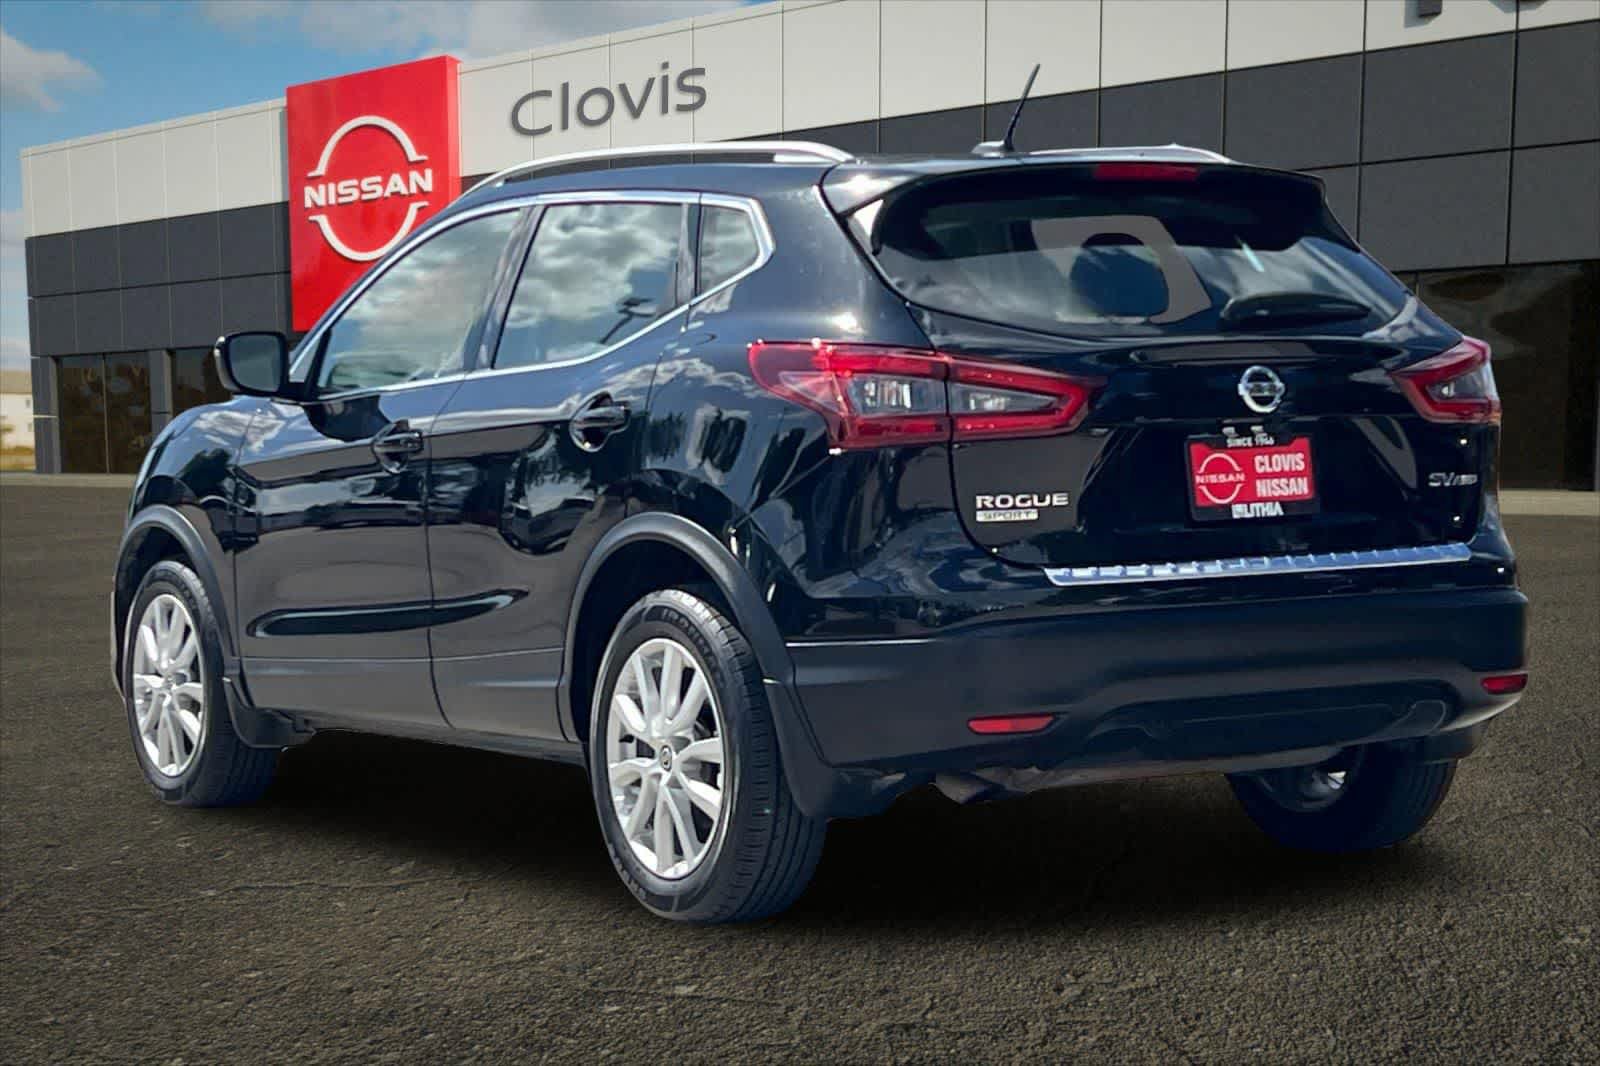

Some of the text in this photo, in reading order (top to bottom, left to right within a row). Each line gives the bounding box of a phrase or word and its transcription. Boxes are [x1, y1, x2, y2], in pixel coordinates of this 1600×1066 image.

[511, 61, 707, 136] Clovis
[304, 167, 433, 208] NISSAN
[1254, 453, 1305, 473] CLOVIS
[1195, 473, 1246, 484] NISSAN
[1255, 477, 1309, 498] NISSAN
[975, 493, 1069, 509] ROGUE
[981, 510, 1033, 520] SPORT
